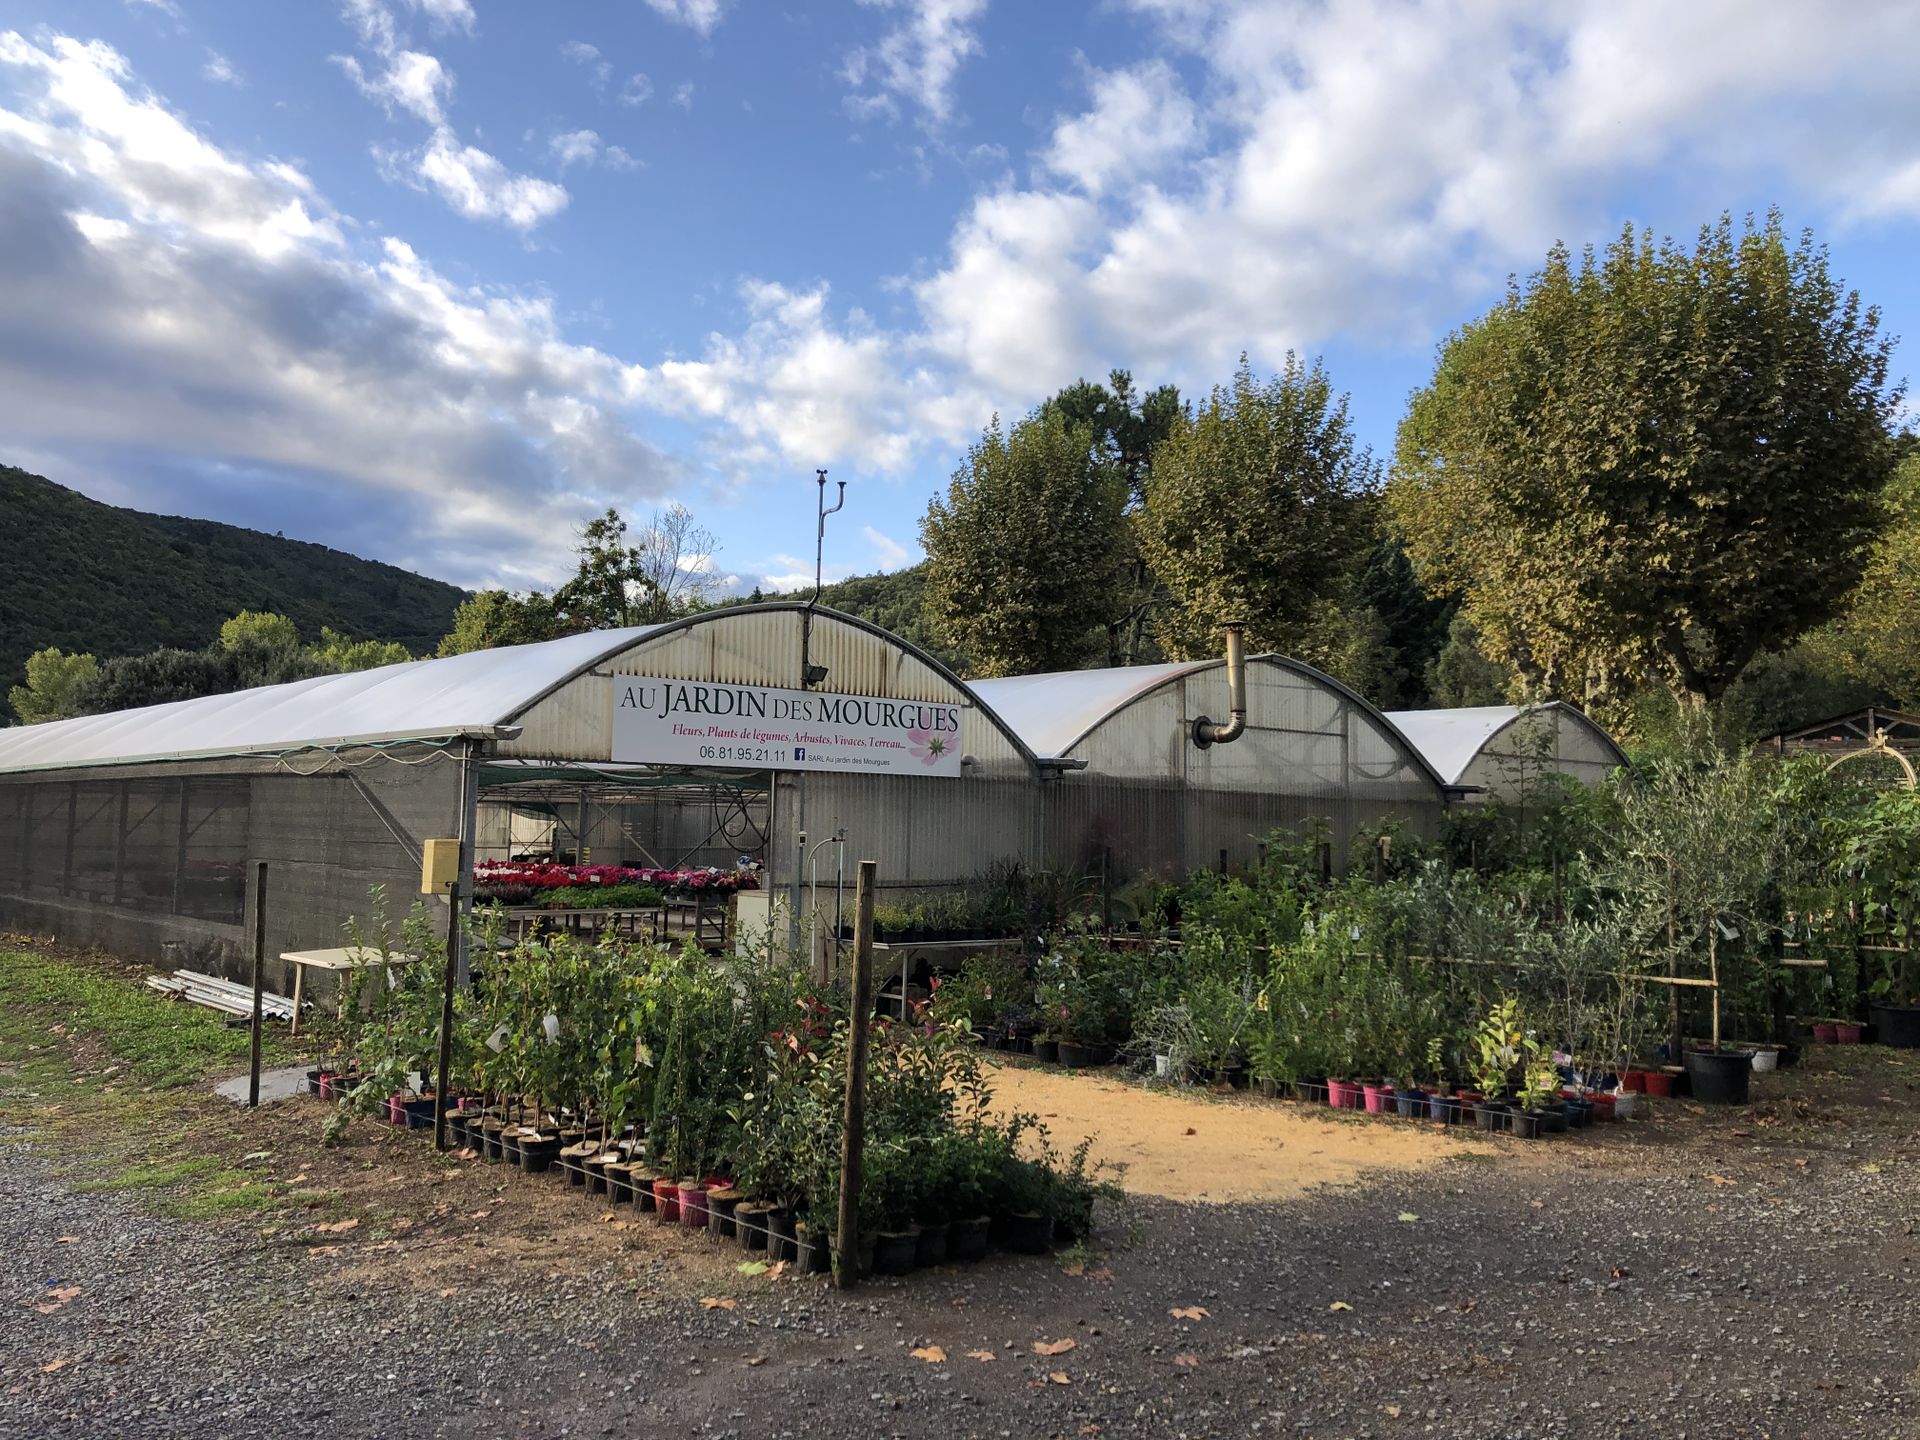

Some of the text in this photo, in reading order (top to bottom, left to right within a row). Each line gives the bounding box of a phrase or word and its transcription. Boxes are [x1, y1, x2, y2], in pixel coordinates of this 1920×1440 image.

[620, 683, 959, 732] AU JARDIN DES MOURGUES
[672, 723, 705, 738] Fleurs,
[707, 725, 738, 739] Plants
[740, 727, 751, 740] de
[753, 728, 791, 744] légumes,
[793, 731, 832, 745] Arbustes,
[834, 734, 867, 747] Vivaces,
[700, 745, 785, 762] 06.81.95.21.11
[808, 754, 824, 763] SARL
[834, 757, 850, 765] jardin
[852, 757, 862, 765] des
[864, 757, 890, 767] Mourgues
